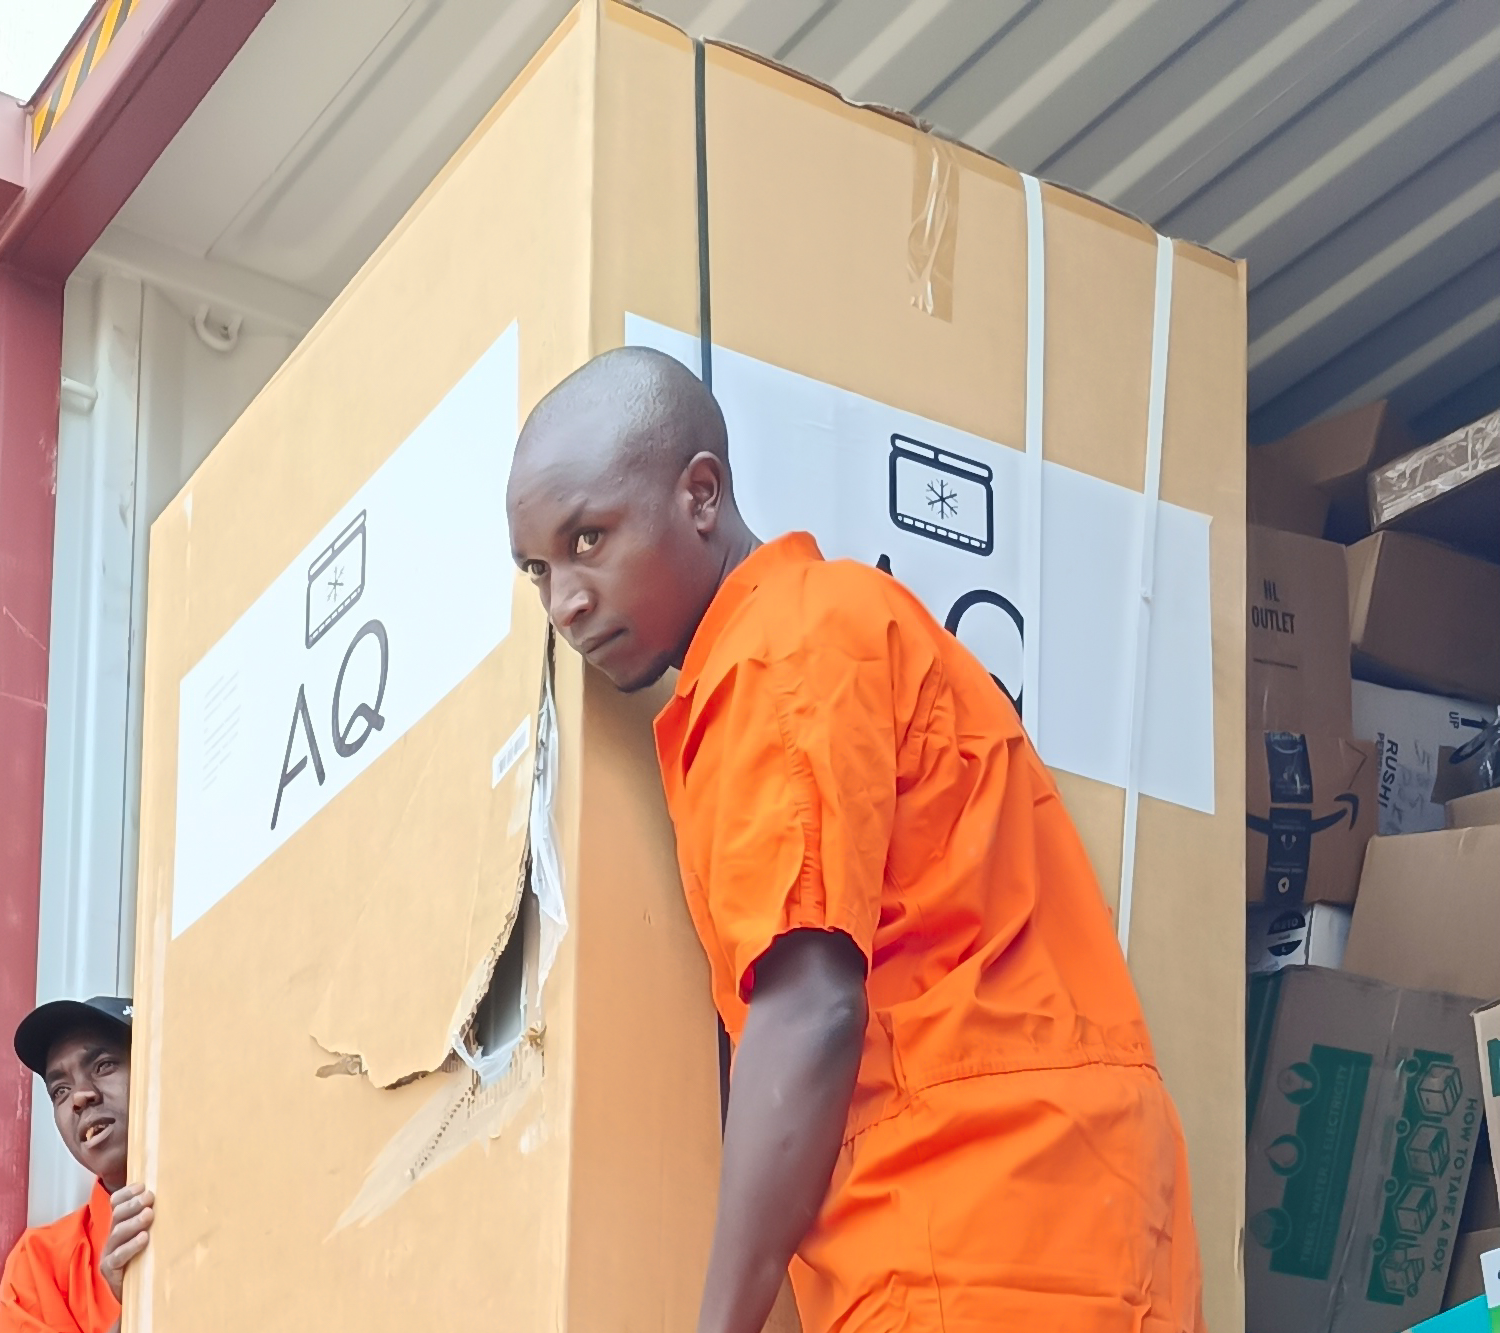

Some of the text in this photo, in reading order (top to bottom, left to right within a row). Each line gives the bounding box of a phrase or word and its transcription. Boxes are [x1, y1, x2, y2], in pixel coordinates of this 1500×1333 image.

[1252, 605, 1296, 635] OUTLET
[270, 618, 389, 831] AQ
[1448, 711, 1460, 729] UP
[1323, 1063, 1349, 1151] ELECTRICITY
[1430, 1098, 1478, 1273] HOW TO TAPE A BOX
